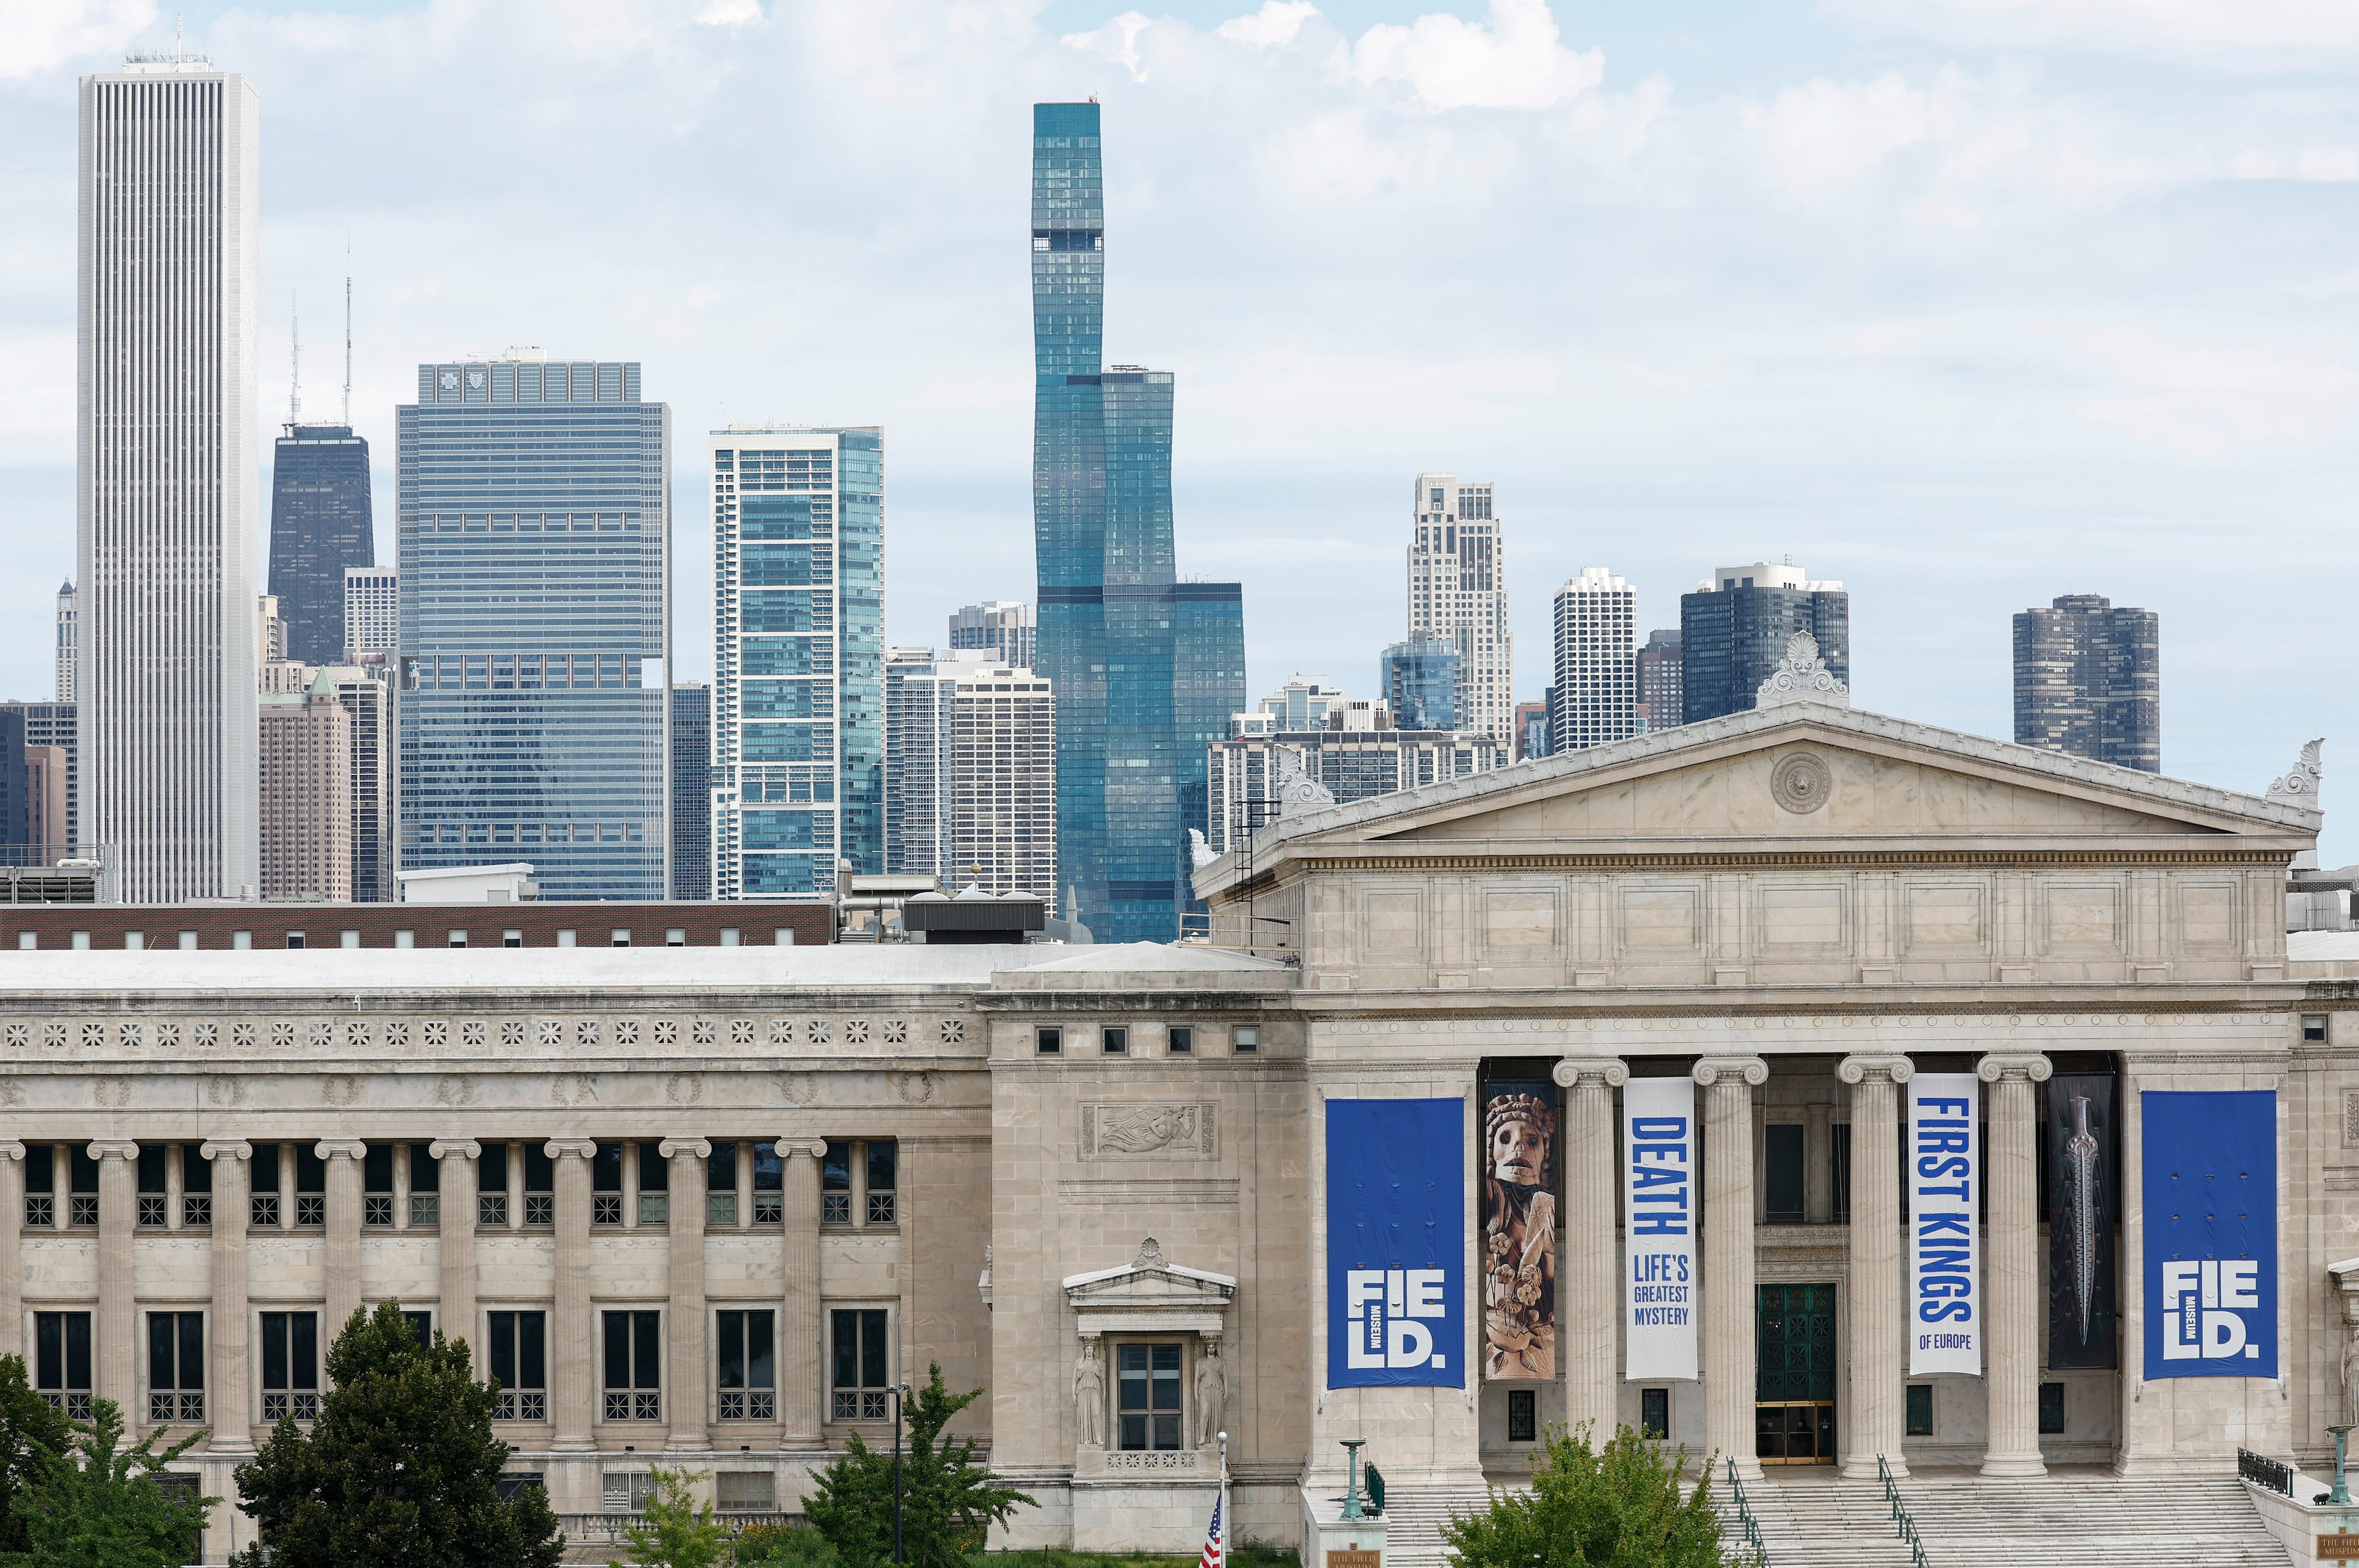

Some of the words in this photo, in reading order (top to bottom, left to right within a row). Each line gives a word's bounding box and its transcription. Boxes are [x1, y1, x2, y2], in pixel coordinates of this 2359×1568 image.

[1917, 1098, 1970, 1202] FIRST
[1632, 1117, 1688, 1235] DEATH
[1919, 1213, 1972, 1323] KINGS
[1634, 1285, 1689, 1303] GREATEST
[1371, 1305, 1381, 1349] MUSEUM
[1635, 1307, 1689, 1326] MYSTERY
[2185, 1296, 2196, 1340] MUSEUM
[1919, 1334, 1931, 1350] OF
[1935, 1333, 1971, 1349] EUROPE
